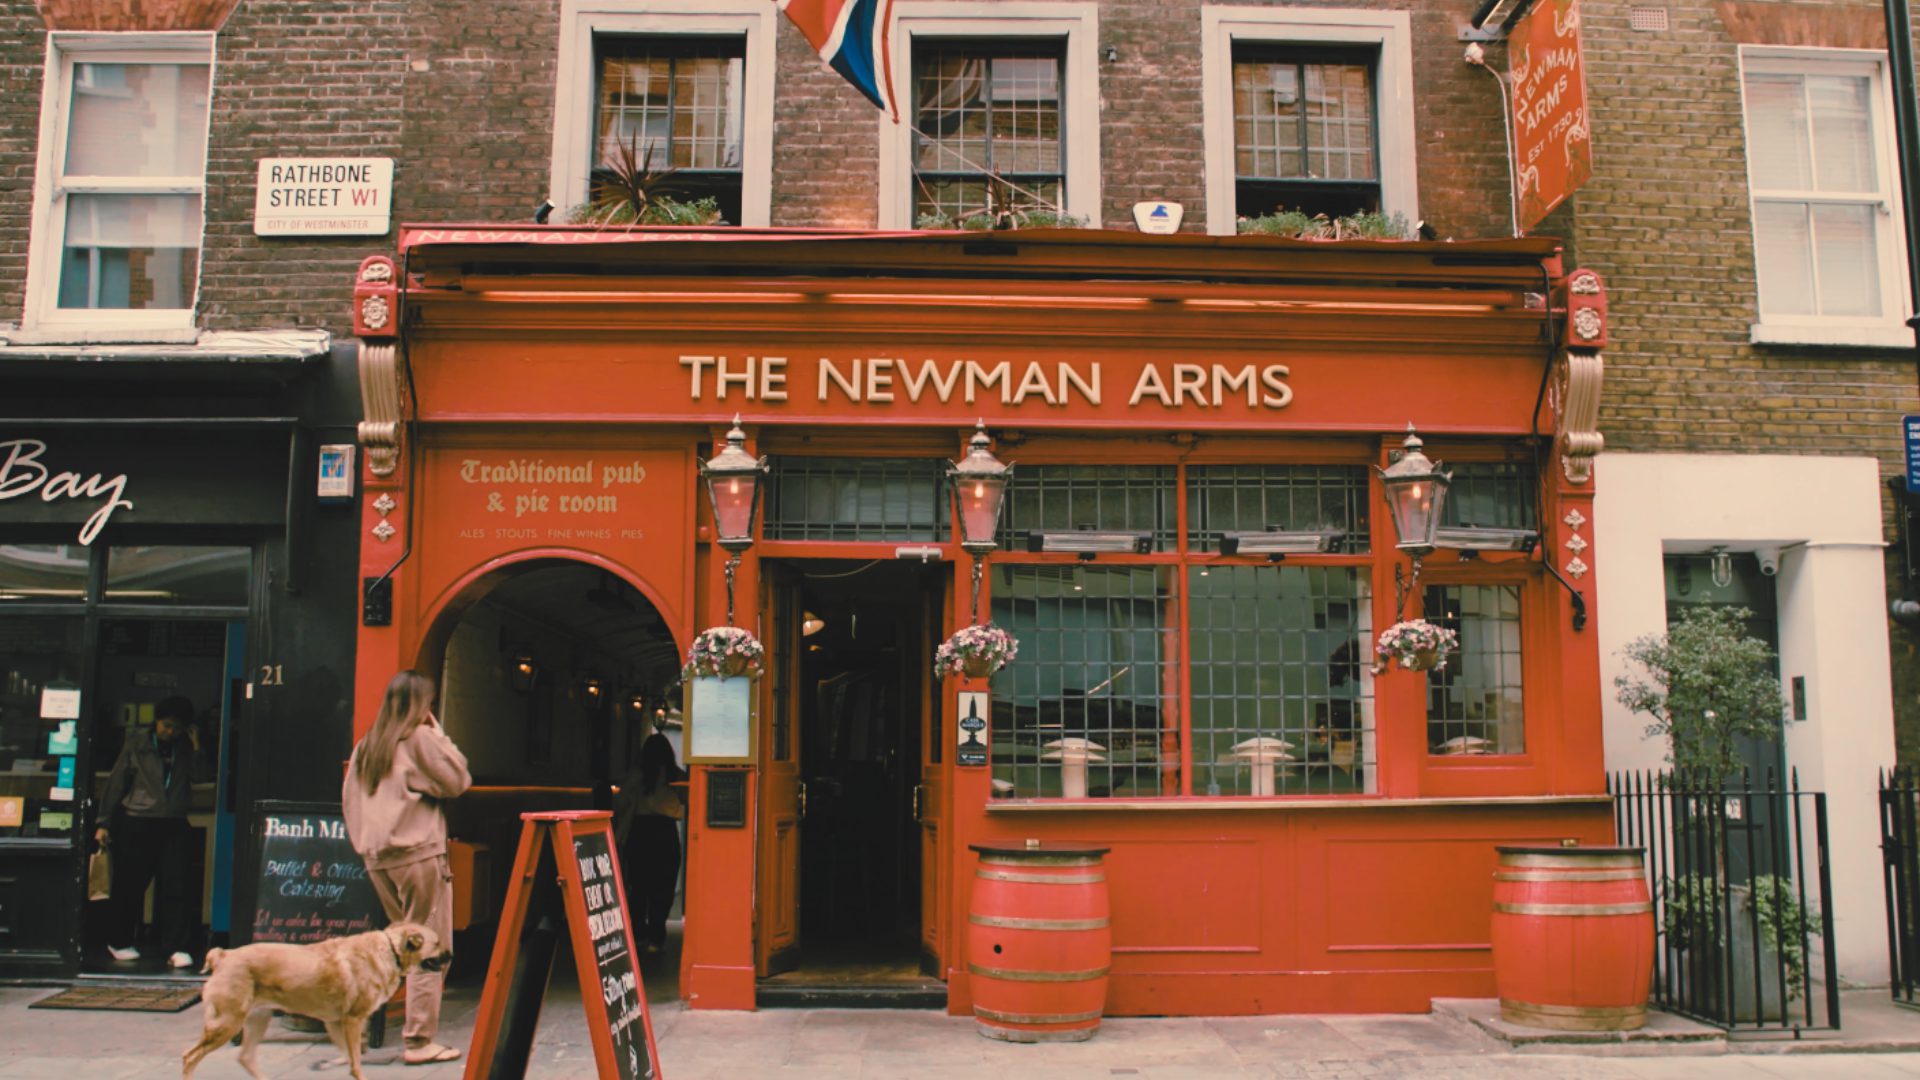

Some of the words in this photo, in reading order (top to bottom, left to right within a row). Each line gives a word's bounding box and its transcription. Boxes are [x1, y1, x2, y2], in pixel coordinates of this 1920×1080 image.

[1517, 47, 1577, 124] NEWMAN
[1525, 73, 1568, 137] ARMS
[1527, 138, 1545, 164] EST
[1548, 110, 1573, 143] 1730
[271, 164, 372, 183] RATHBONE
[270, 188, 342, 207] STREET
[351, 188, 378, 206] W1
[267, 220, 287, 230] CITY
[290, 220, 301, 230] OF
[304, 220, 369, 230] WESTMINSTER
[417, 230, 598, 242] NEWMAN
[679, 355, 788, 400] THE
[818, 358, 1101, 405] NEWMAN
[1128, 362, 1293, 408] ARMS
[460, 459, 593, 483] Traditional
[603, 461, 646, 488] pub
[0, 439, 133, 546] Bay
[487, 491, 505, 512] &
[515, 489, 550, 518] pie
[559, 495, 618, 512] room
[460, 528, 485, 539] ALES
[496, 528, 537, 539] STOUTS
[547, 528, 573, 539] FINE
[576, 528, 611, 539] WINES
[621, 528, 643, 539] PIES
[261, 665, 284, 685] 21
[264, 817, 313, 838] Banh
[319, 819, 346, 839] Mi
